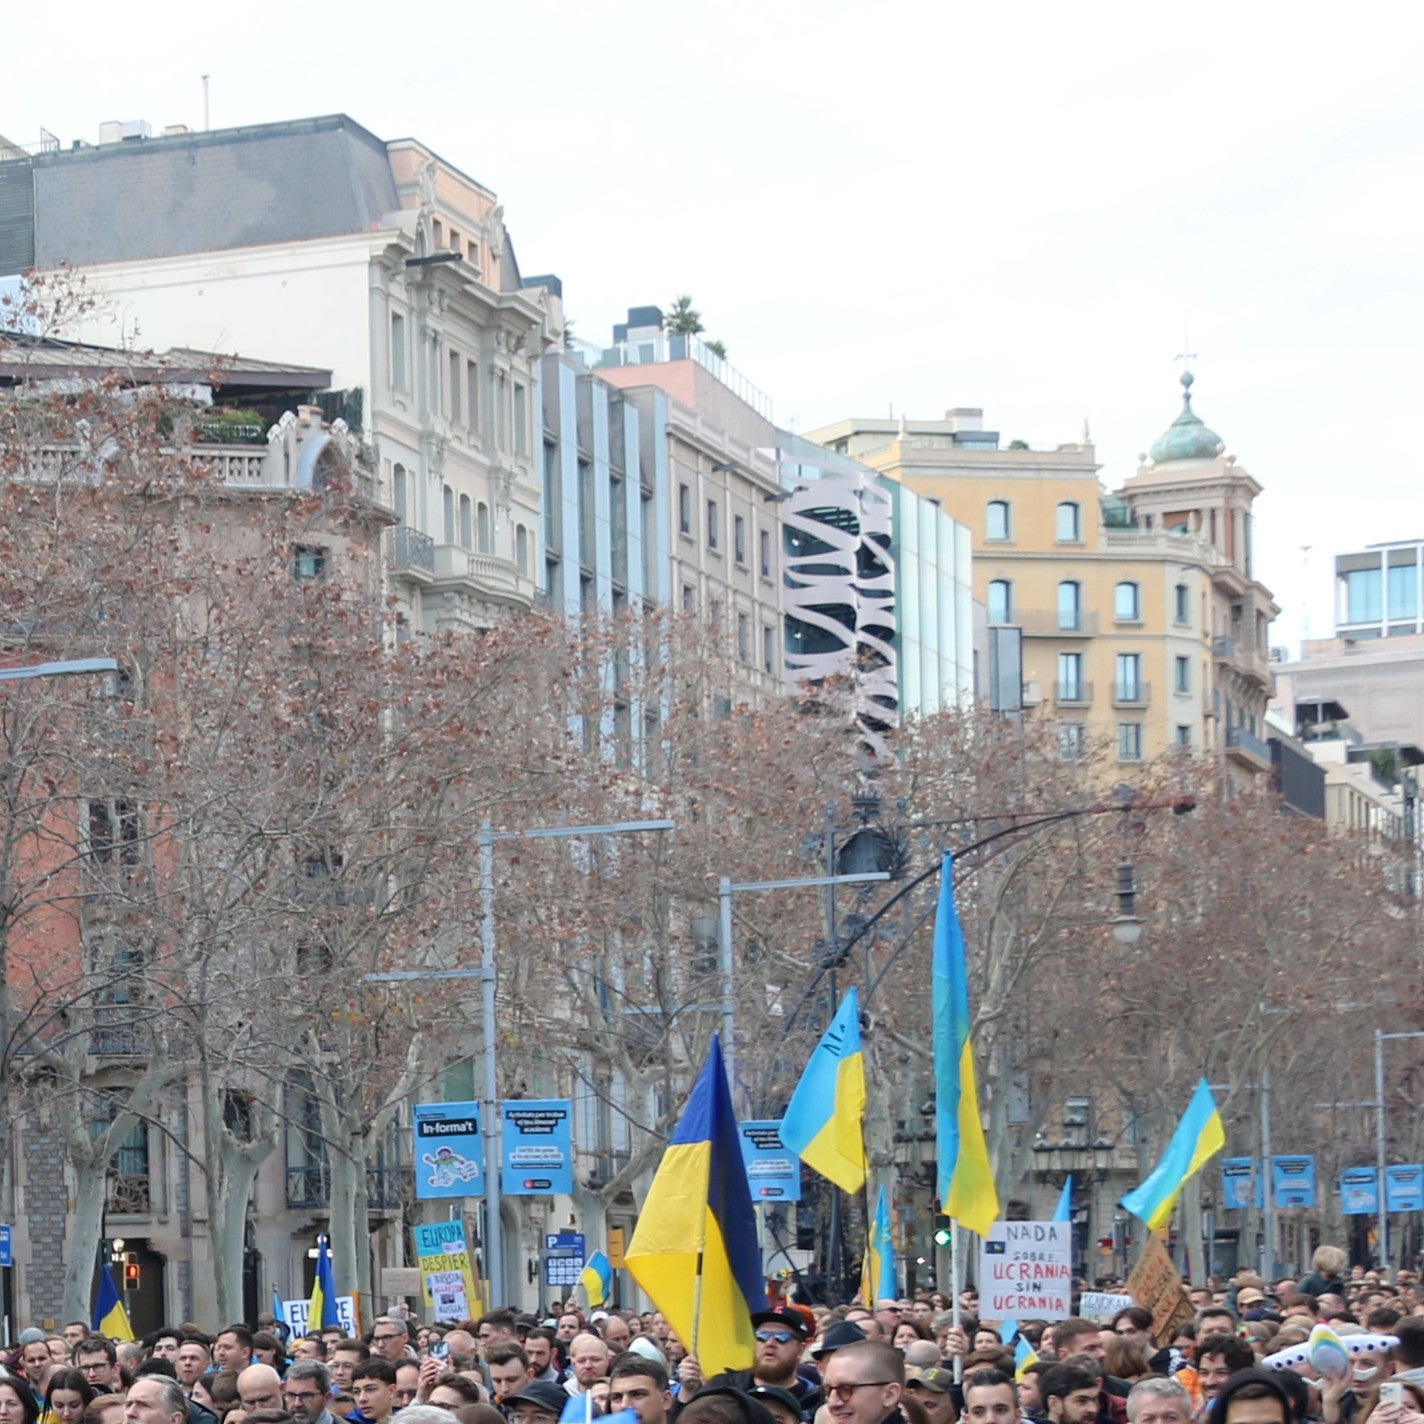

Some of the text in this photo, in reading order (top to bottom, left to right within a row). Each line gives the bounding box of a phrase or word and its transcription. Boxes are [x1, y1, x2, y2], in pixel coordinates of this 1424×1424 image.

[422, 1121, 473, 1134] In-forma't
[421, 1225, 463, 1248] EUROPA
[1006, 1225, 1057, 1241] NADA
[547, 1236, 558, 1248] P
[1013, 1251, 1055, 1262] SOBRE
[994, 1262, 1071, 1280] UCRANIA
[1015, 1281, 1042, 1292] SIN
[994, 1295, 1064, 1311] UCRANIA
